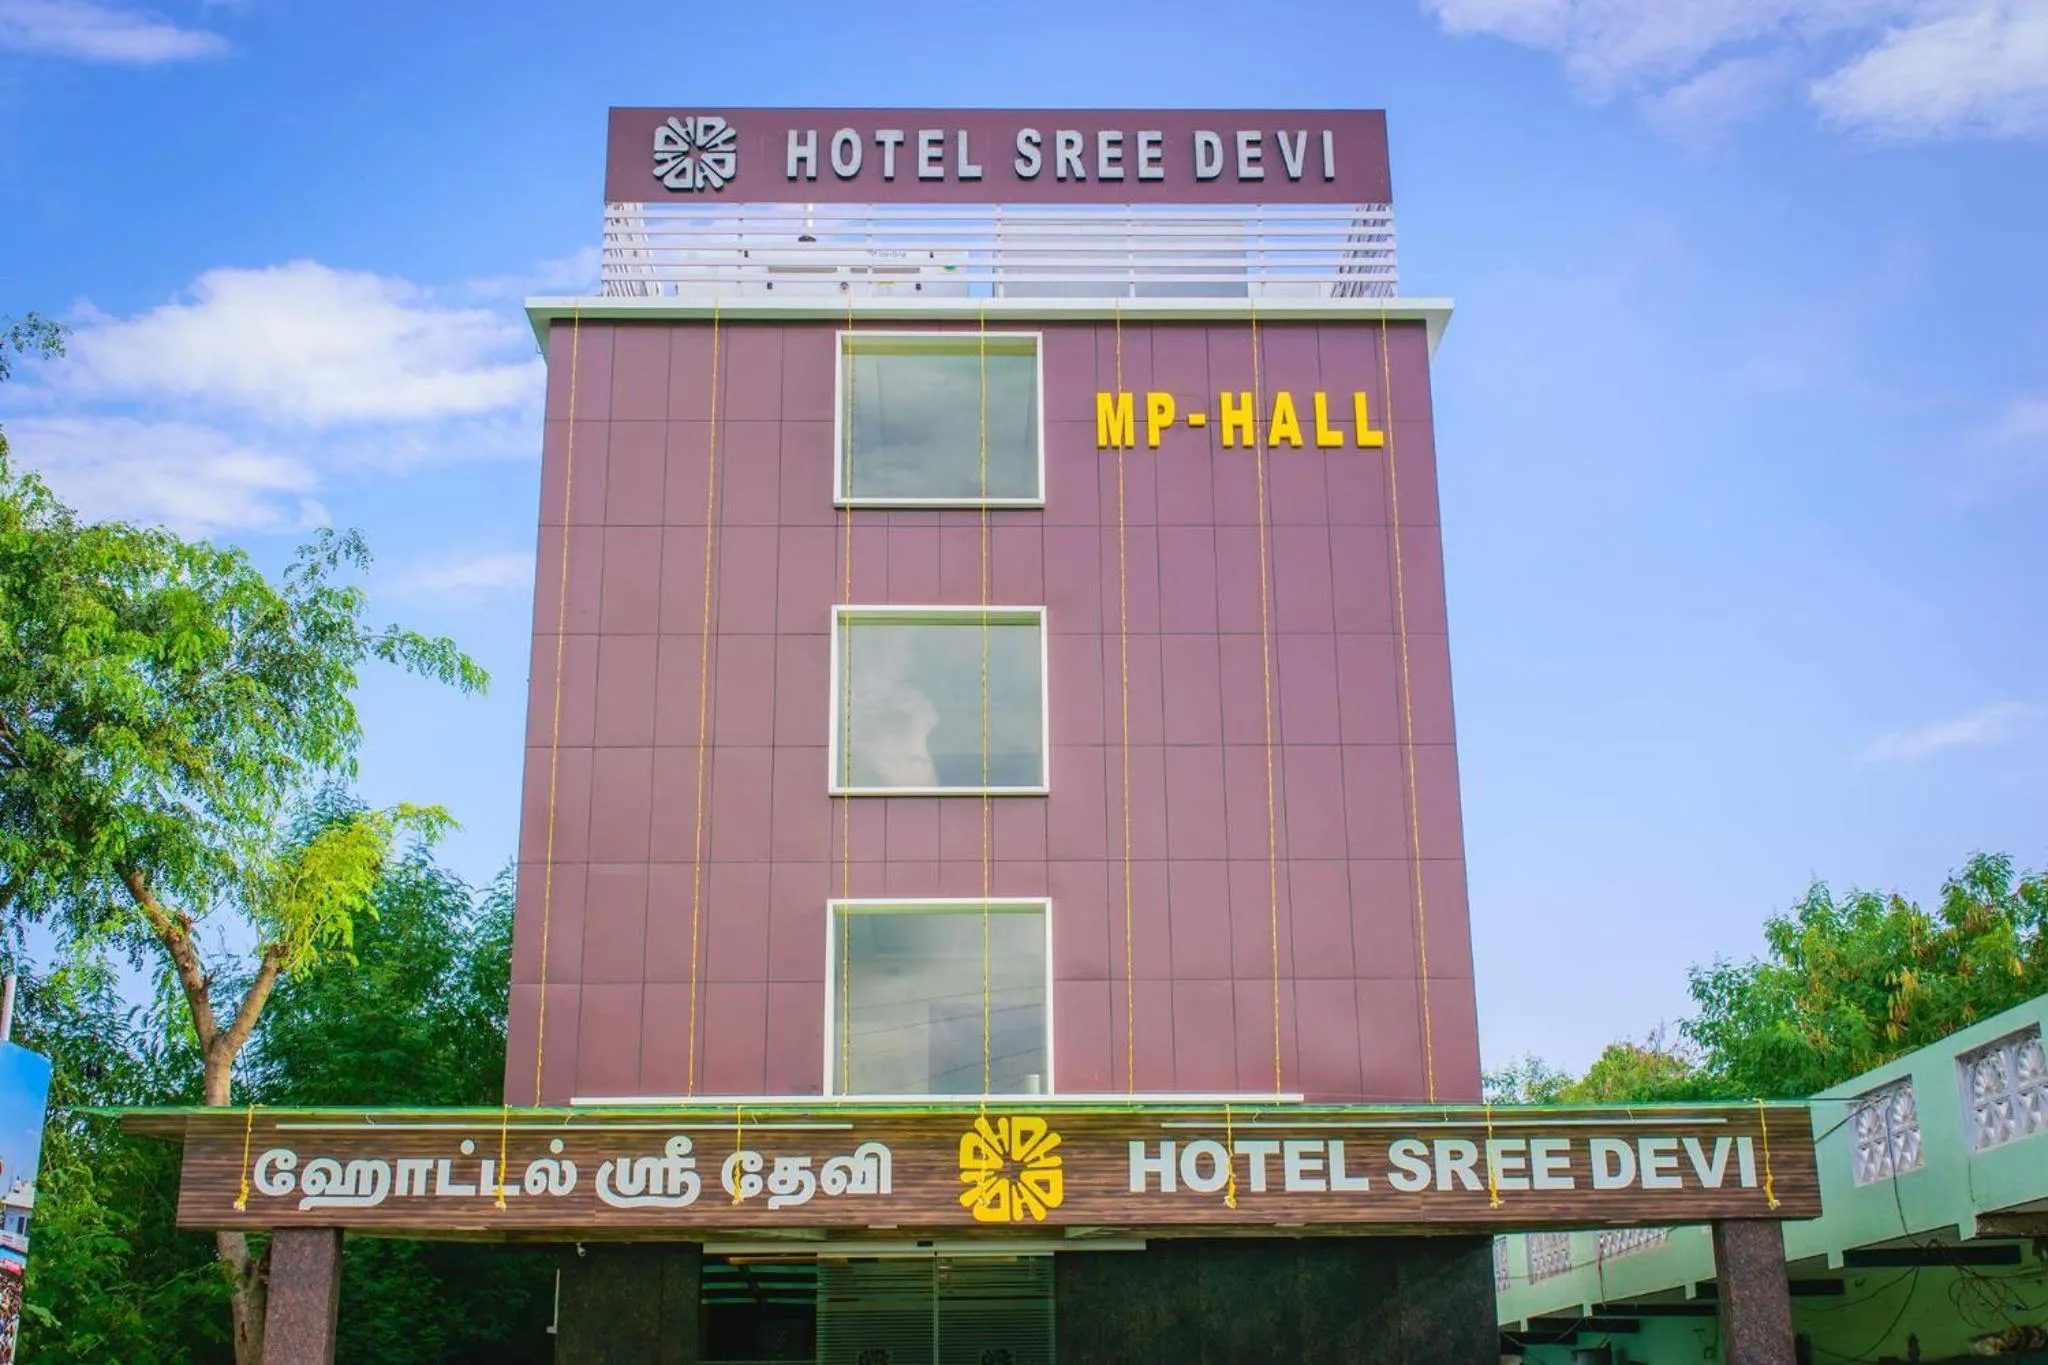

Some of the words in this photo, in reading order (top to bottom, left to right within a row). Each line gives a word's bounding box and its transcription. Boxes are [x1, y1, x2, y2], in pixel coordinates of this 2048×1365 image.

[786, 127, 983, 181] HOTEL
[1013, 127, 1165, 182] SREE
[1193, 129, 1336, 182] DEVI
[1095, 391, 1385, 449] MP-HALL
[253, 1138, 578, 1211] ஹோட்டல்
[721, 1141, 893, 1210] தேவி
[1128, 1138, 1371, 1193] HOTEL
[1387, 1137, 1576, 1193] SREE
[1588, 1135, 1759, 1190] DEVI
